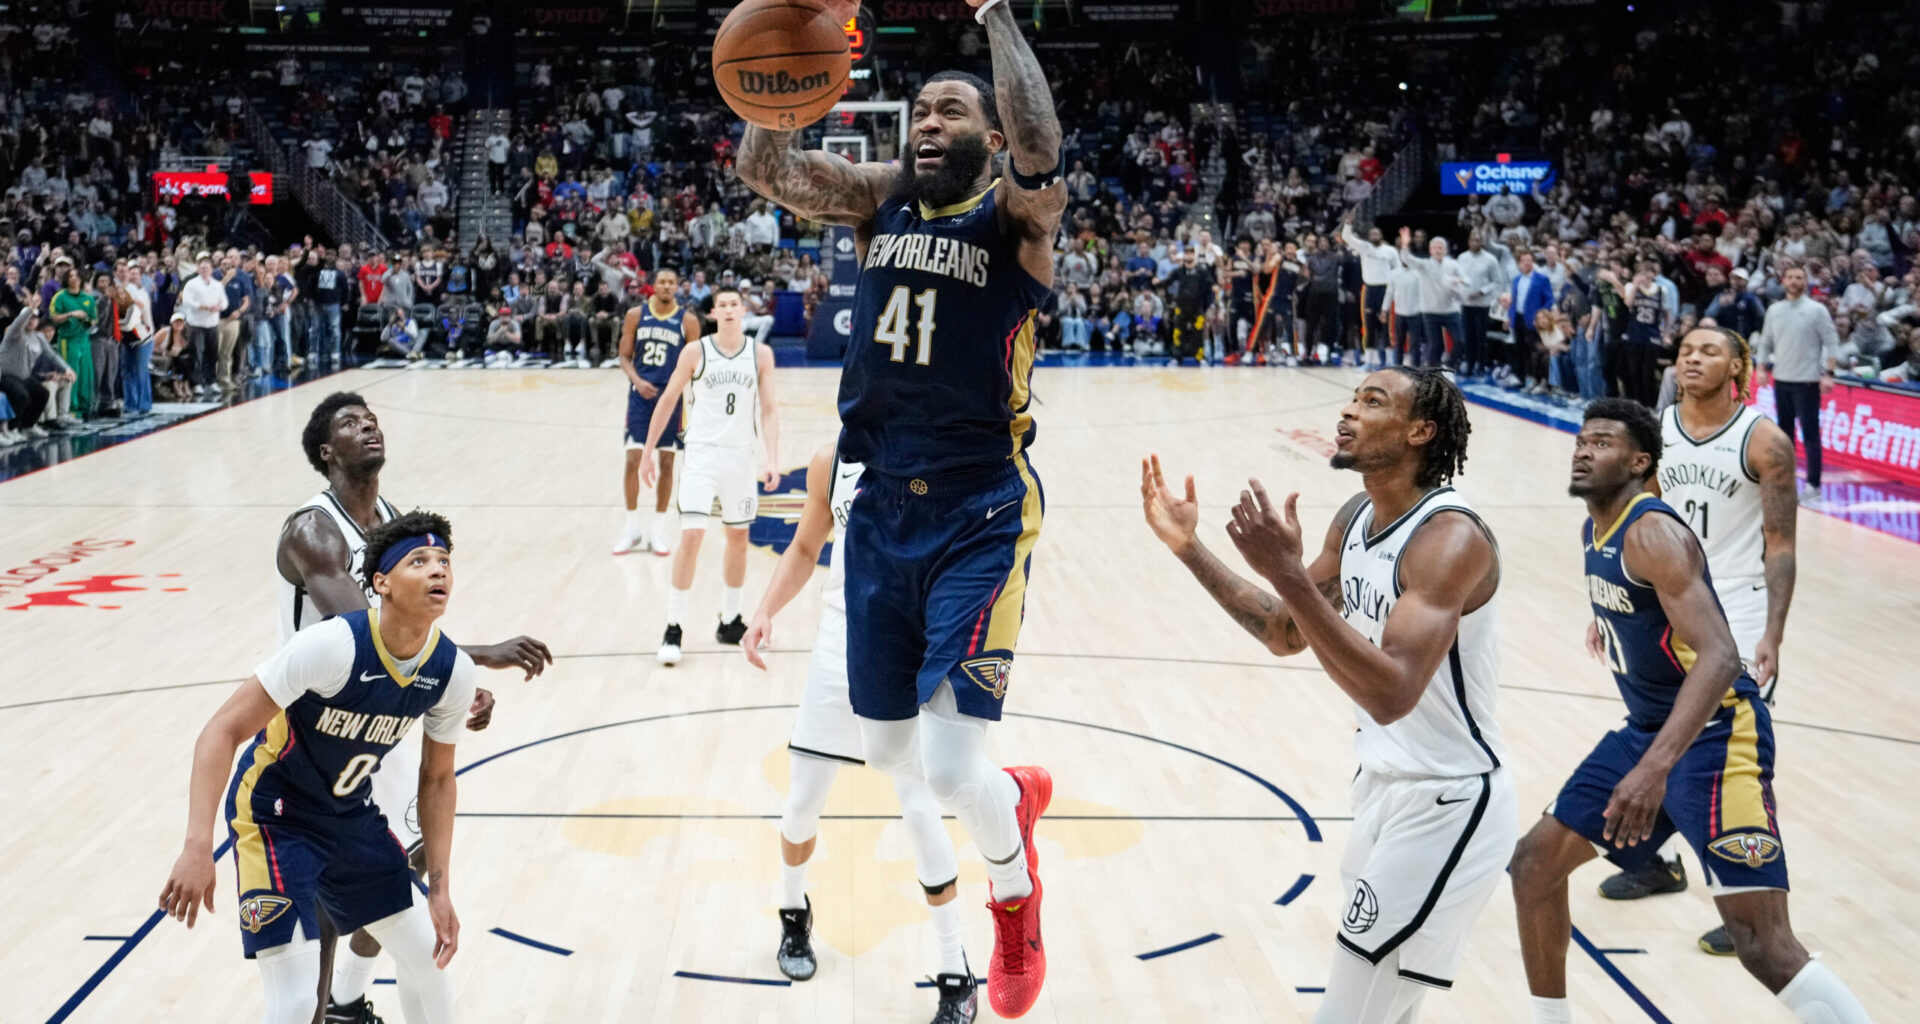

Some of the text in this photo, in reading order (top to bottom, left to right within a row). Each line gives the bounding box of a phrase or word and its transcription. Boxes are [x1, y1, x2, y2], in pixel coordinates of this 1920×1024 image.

[737, 69, 830, 95] Wilson
[1475, 164, 1548, 180] Ochsne
[864, 233, 989, 288] NEW ORLEANS
[652, 327, 680, 347] ORLEANS
[874, 285, 937, 366] 41
[643, 341, 667, 367] 25
[703, 368, 755, 390] BROOKLYN
[726, 392, 736, 416] 8
[1660, 463, 1743, 499] BROOKLYN
[1685, 499, 1709, 540] 21
[1596, 615, 1629, 675] 21
[414, 675, 440, 686] EWAGE
[315, 706, 371, 740] NEW
[332, 753, 378, 797] 0
